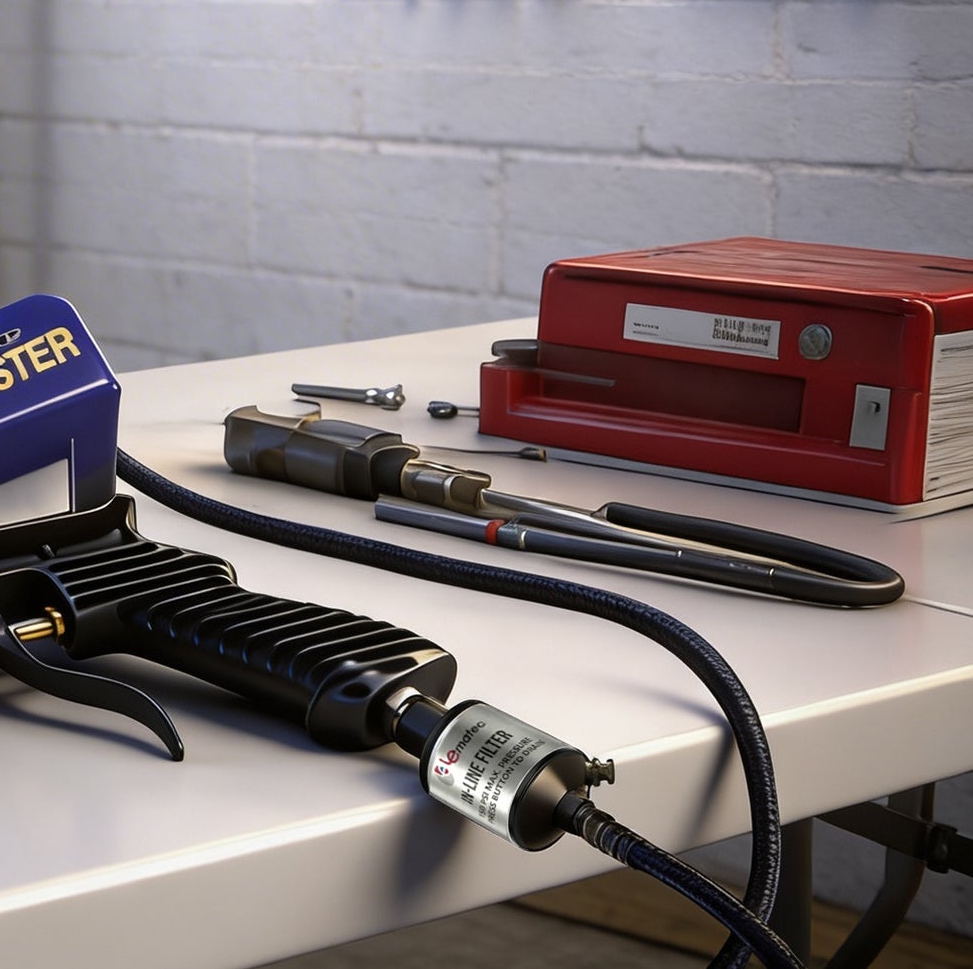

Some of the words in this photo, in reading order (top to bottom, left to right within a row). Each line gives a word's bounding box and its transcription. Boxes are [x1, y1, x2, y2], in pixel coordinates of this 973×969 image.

[461, 762, 485, 805] IN-LINE
[475, 730, 513, 764] FILTER
[481, 792, 489, 805] PSI
[498, 736, 533, 768] PRESSURE
[492, 767, 515, 801] BUTTON
[512, 756, 524, 766] TO
